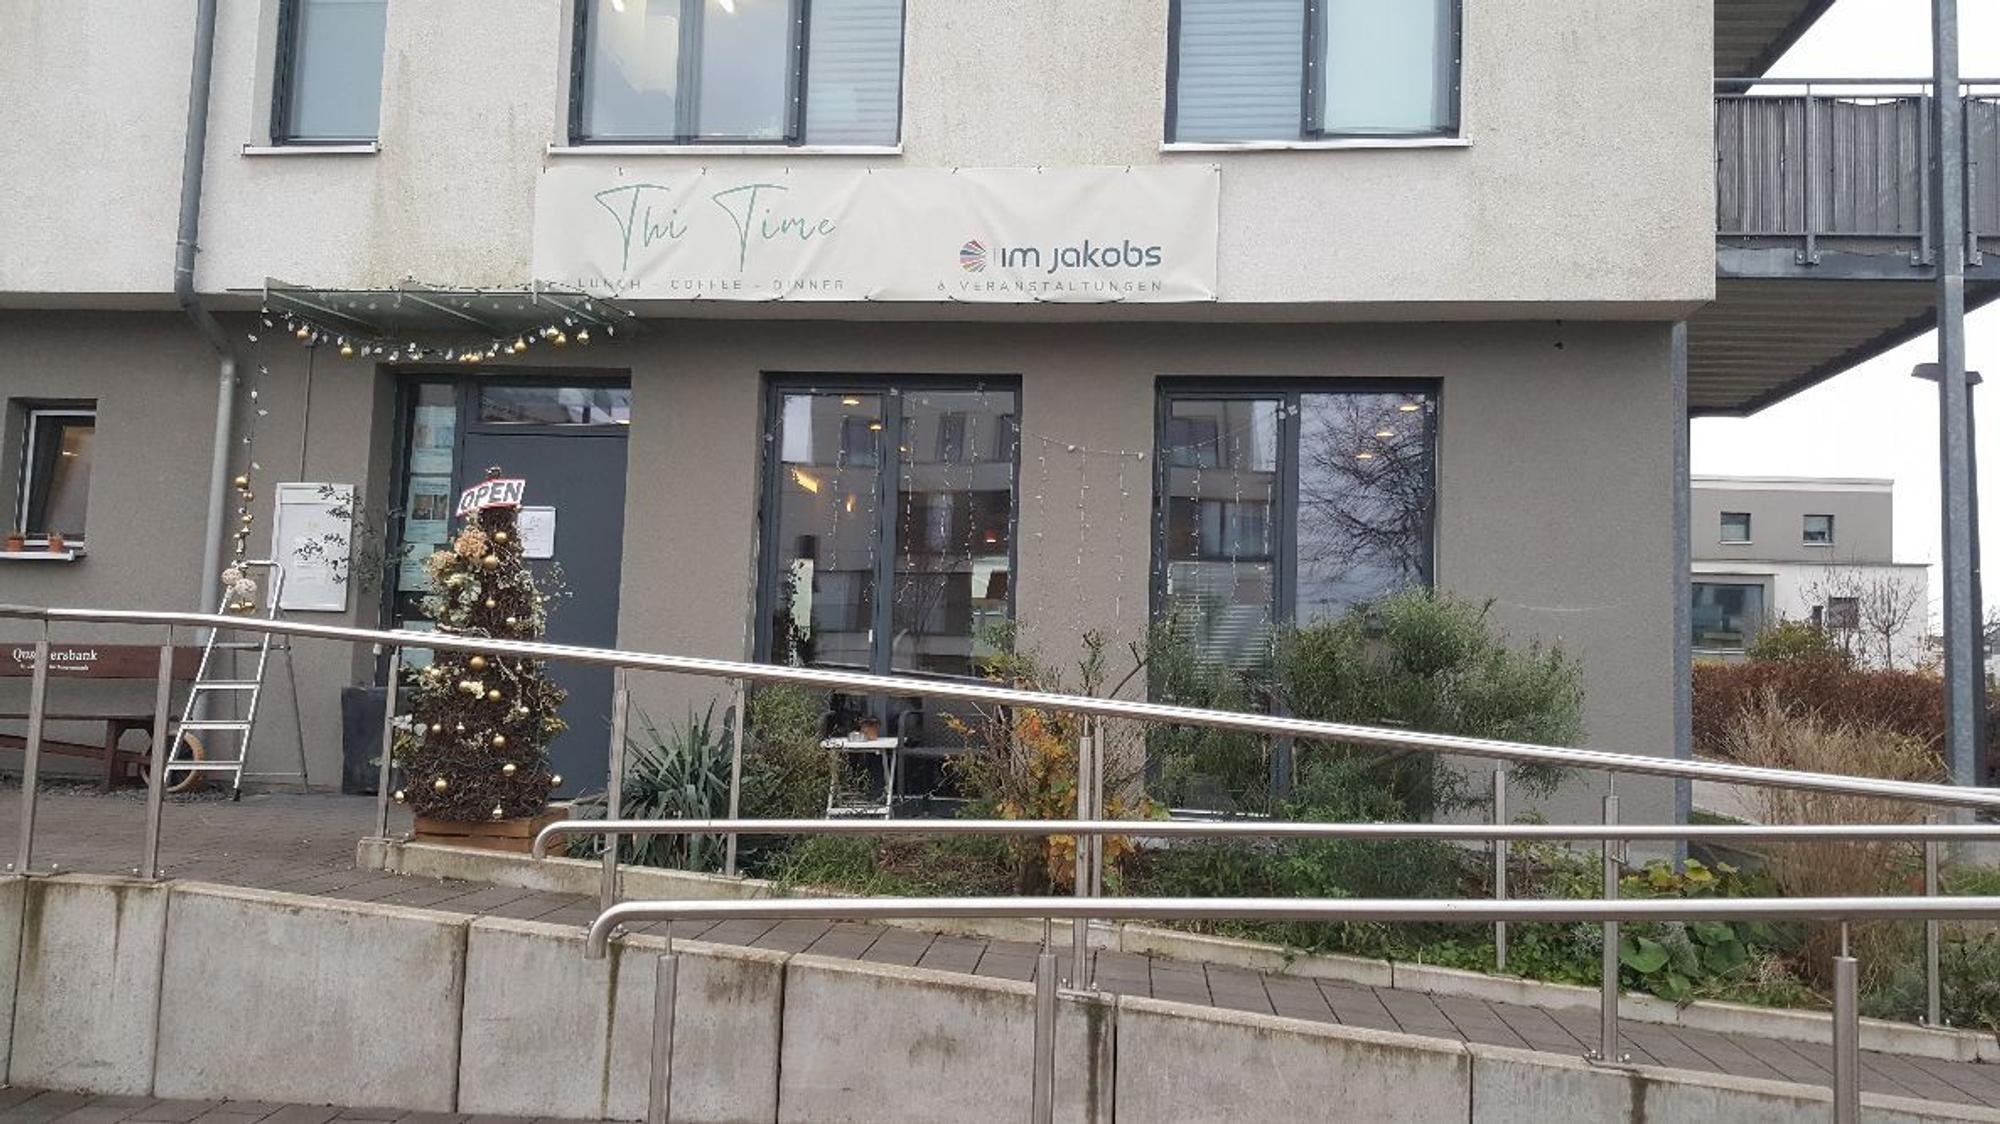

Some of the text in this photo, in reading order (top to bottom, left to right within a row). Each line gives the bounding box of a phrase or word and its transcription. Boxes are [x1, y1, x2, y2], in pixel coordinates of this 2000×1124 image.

[711, 183, 836, 272] Time
[1001, 239, 1162, 274] im jakobs
[578, 278, 641, 291] LUNCH
[671, 279, 742, 290] COFFEE
[773, 279, 844, 291] DINNER
[959, 280, 1163, 292] VERANSTALTUNGEN
[461, 482, 522, 509] OPEN
[13, 648, 97, 662] Quaersbank
